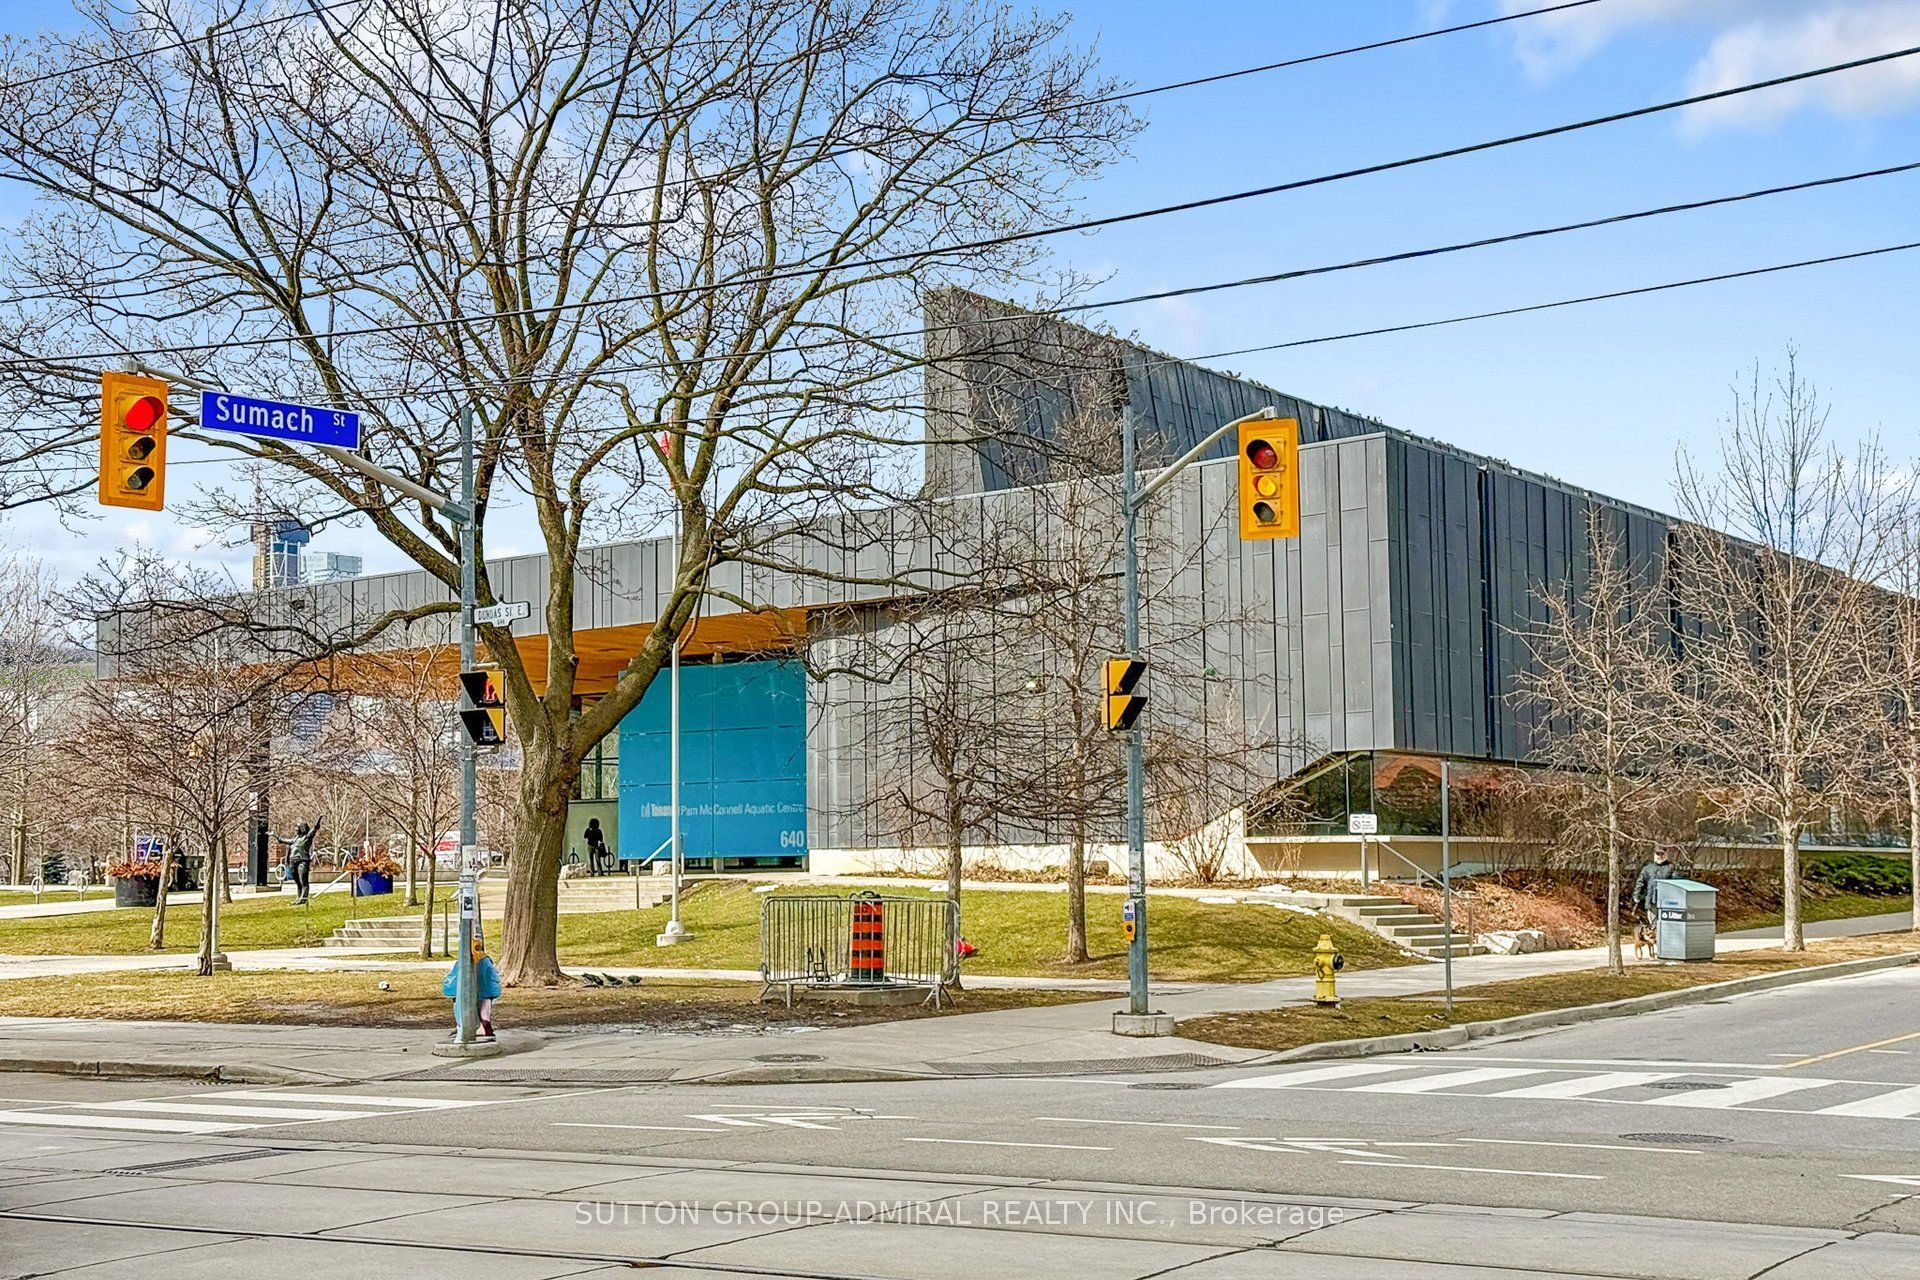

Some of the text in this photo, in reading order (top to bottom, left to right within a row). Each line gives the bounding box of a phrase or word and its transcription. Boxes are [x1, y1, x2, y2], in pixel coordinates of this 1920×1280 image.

[216, 396, 346, 434] Sumach St
[681, 805, 698, 816] Pam
[744, 803, 775, 816] Aquatic
[780, 830, 805, 849] 640
